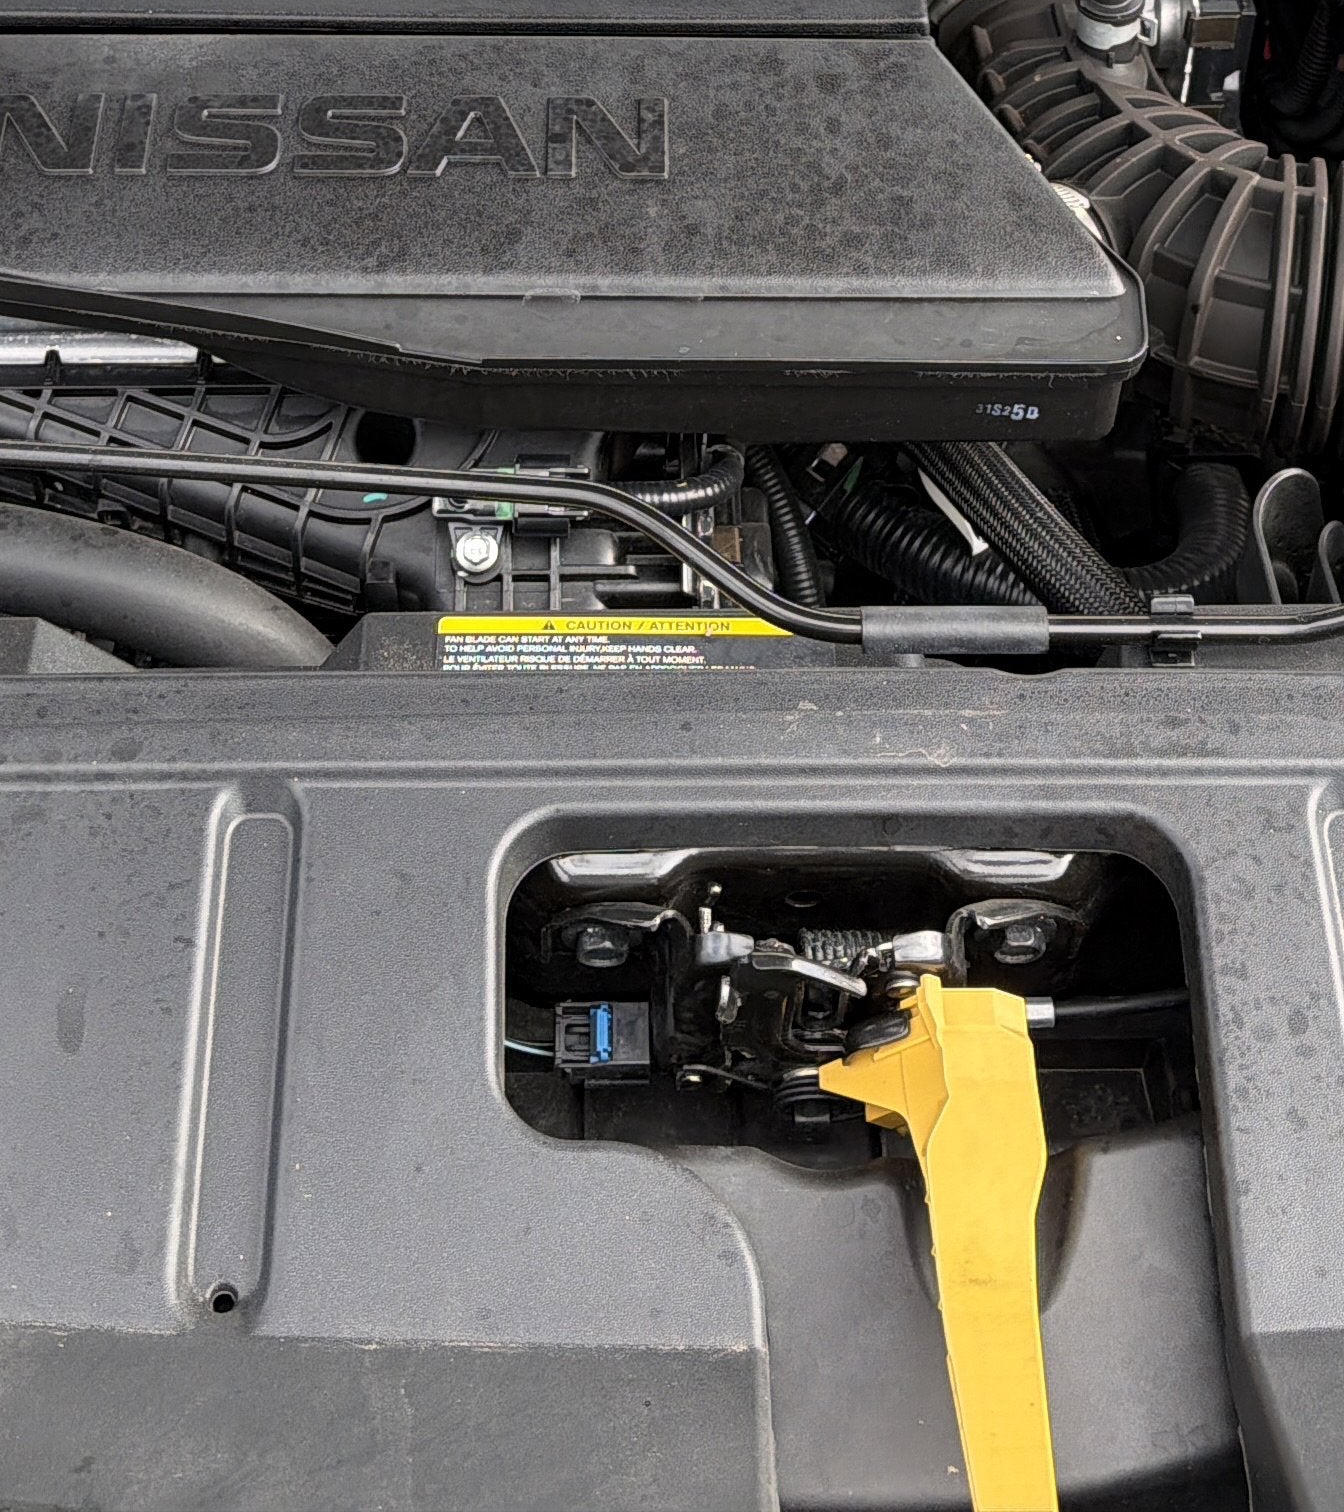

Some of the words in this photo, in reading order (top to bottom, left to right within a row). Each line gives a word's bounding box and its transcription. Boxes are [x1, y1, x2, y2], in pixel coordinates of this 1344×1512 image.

[565, 620, 632, 631] CAUTION
[649, 620, 731, 631] ATTENTION
[445, 635, 464, 644] FAN
[465, 635, 496, 644] BLADE
[498, 635, 519, 644] CAN
[520, 635, 551, 644] START
[552, 635, 563, 644] AT
[564, 635, 586, 644] ANY
[444, 644, 458, 653] TO
[459, 644, 484, 653] HELP
[485, 644, 515, 653] AVOID
[516, 644, 567, 653] PERSONAL
[627, 644, 662, 653] HANDS
[443, 655, 455, 664] LE
[456, 655, 518, 664] VENTILATEUR
[520, 655, 556, 664] RISQUE
[558, 655, 572, 664] DE
[573, 653, 626, 664] DÉMARRER
[626, 653, 635, 664] À
[636, 655, 661, 664] TOUT
